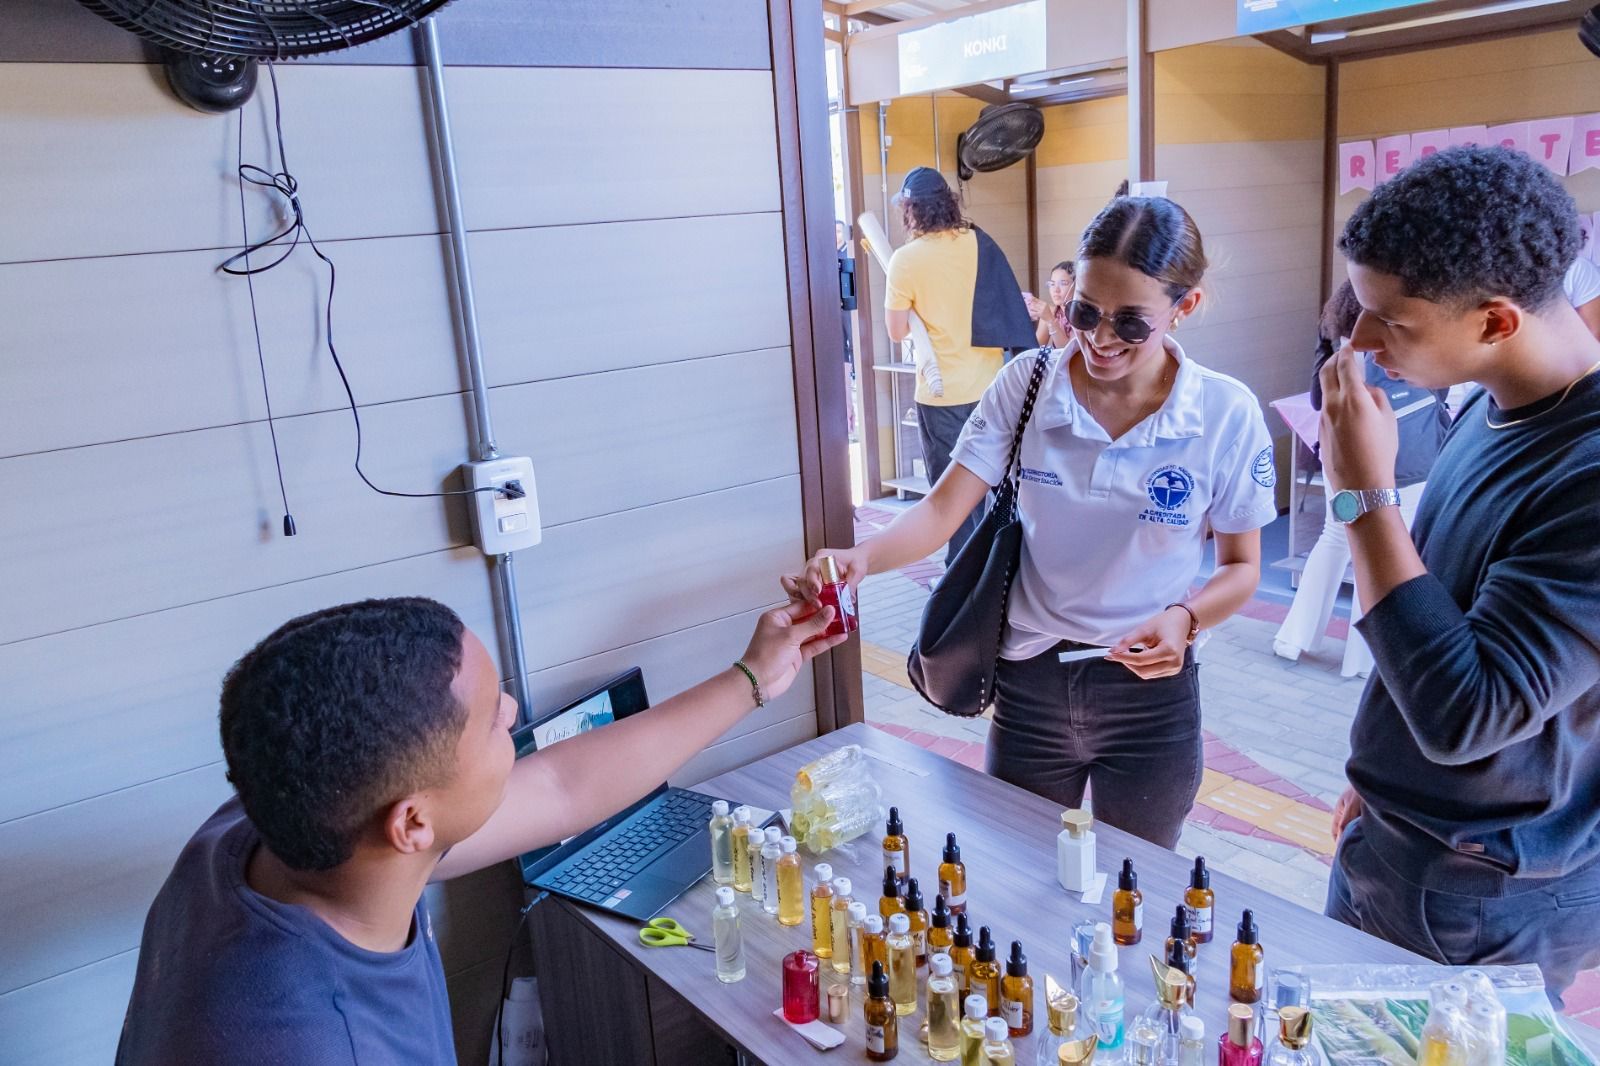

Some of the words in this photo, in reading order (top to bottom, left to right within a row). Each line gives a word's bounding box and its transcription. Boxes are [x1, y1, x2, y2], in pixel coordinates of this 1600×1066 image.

[963, 34, 1008, 58] KONKI
[1138, 513, 1147, 521] EN
[1149, 515, 1164, 523] ALTA
[1166, 518, 1189, 526] CALIDAD
[1143, 508, 1186, 519] ACREDITADA
